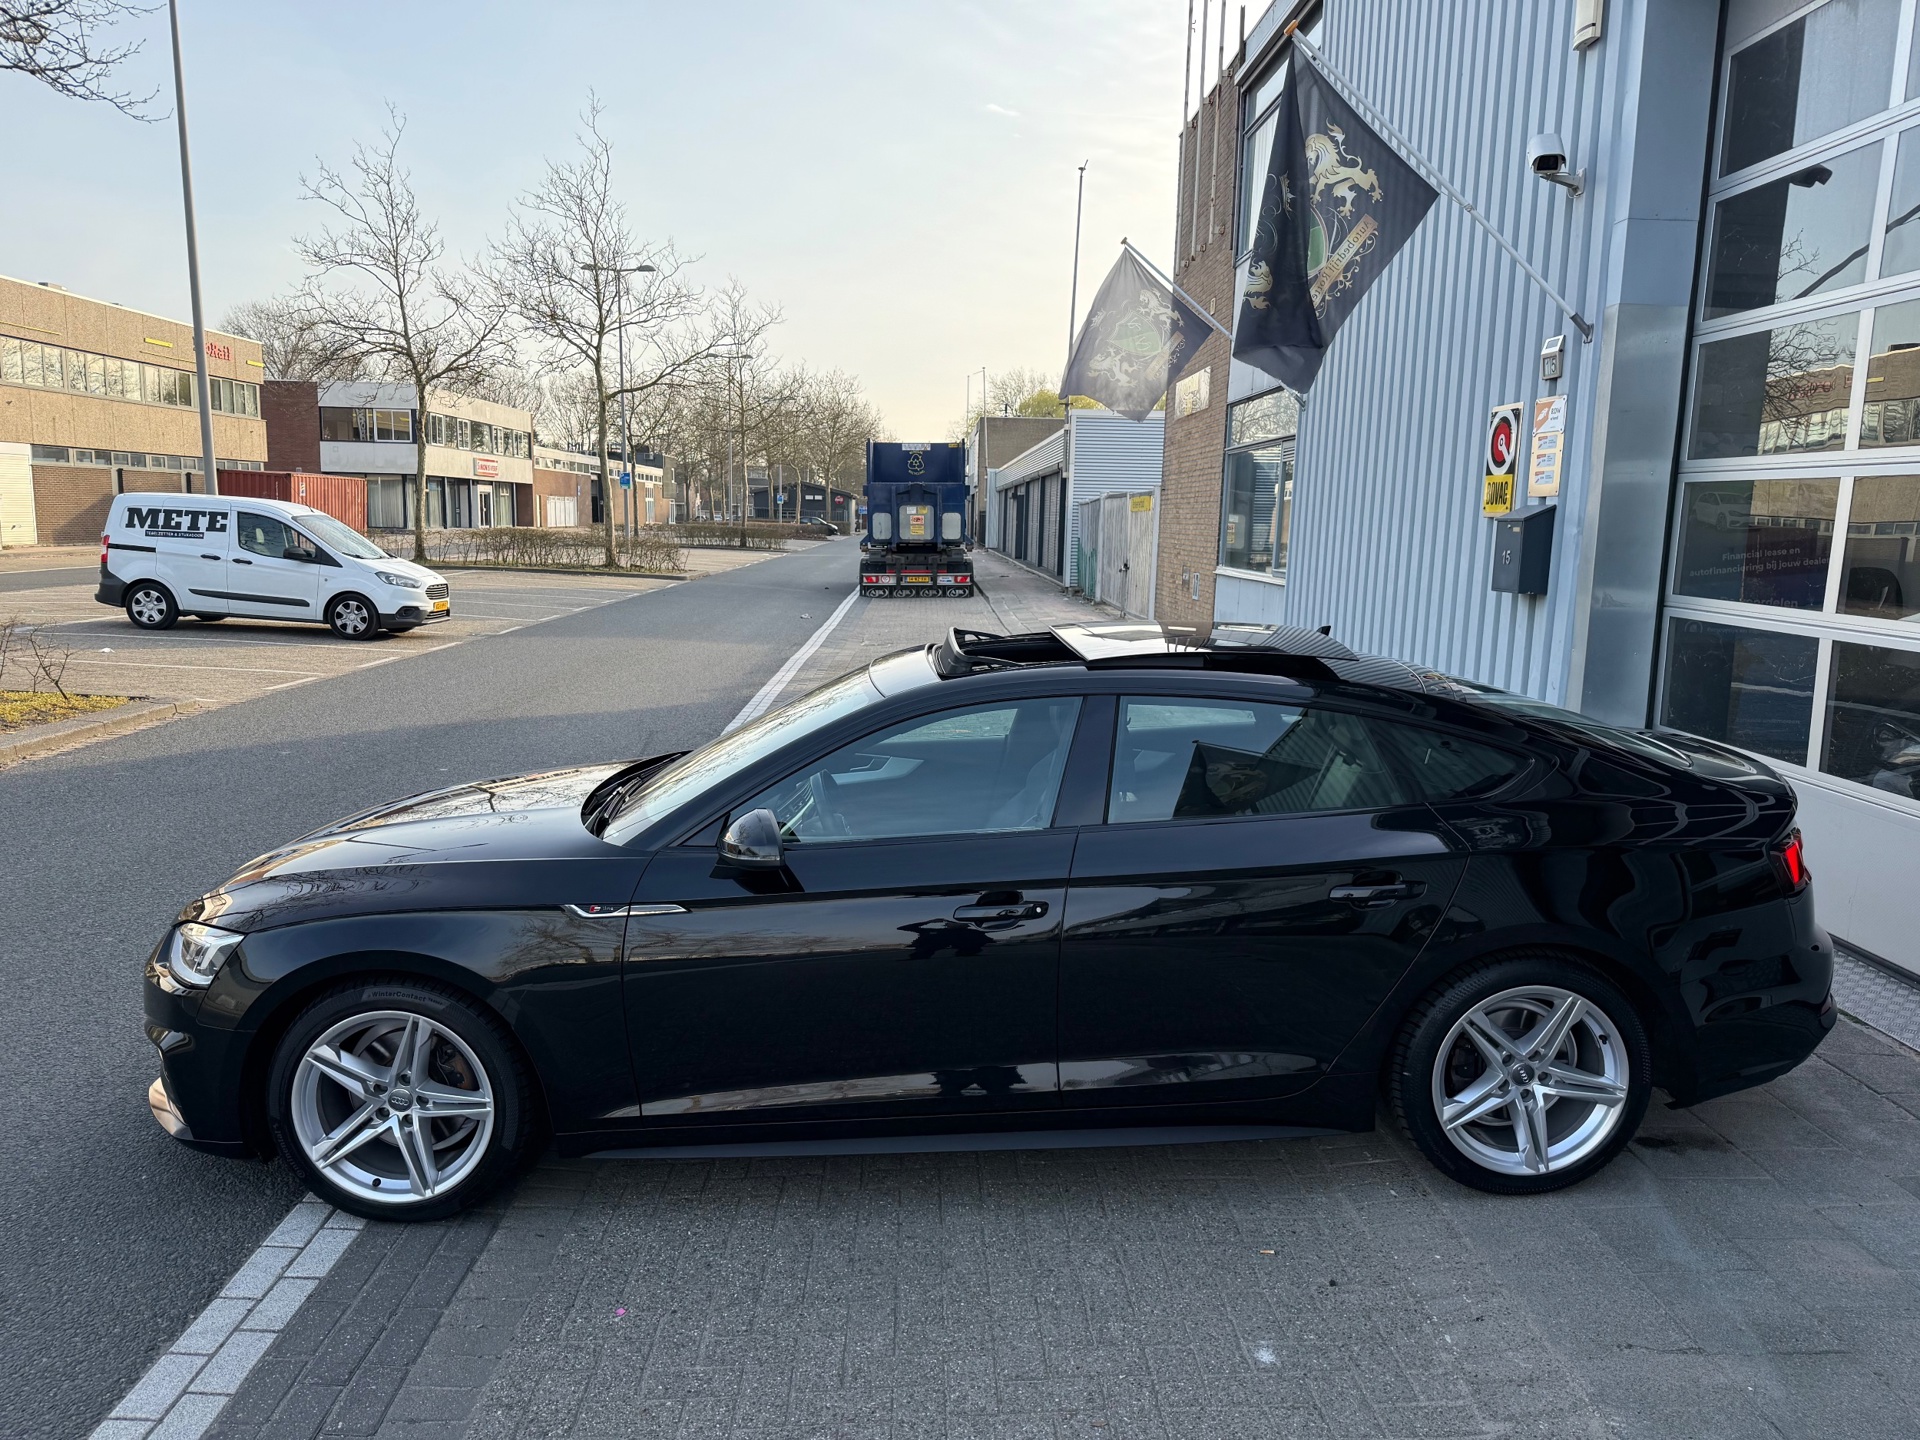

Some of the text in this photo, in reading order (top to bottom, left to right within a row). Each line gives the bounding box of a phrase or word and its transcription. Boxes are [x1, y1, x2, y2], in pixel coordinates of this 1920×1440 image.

[1486, 480, 1509, 506] BOVAG
[125, 508, 229, 533] METE
[1502, 550, 1511, 565] 15
[1722, 547, 1801, 561] Financial lease en
[1689, 563, 1764, 577] autofinanciering
[1766, 560, 1777, 571] bij
[1777, 560, 1801, 570] jouw
[371, 991, 427, 1002] WinterContact
